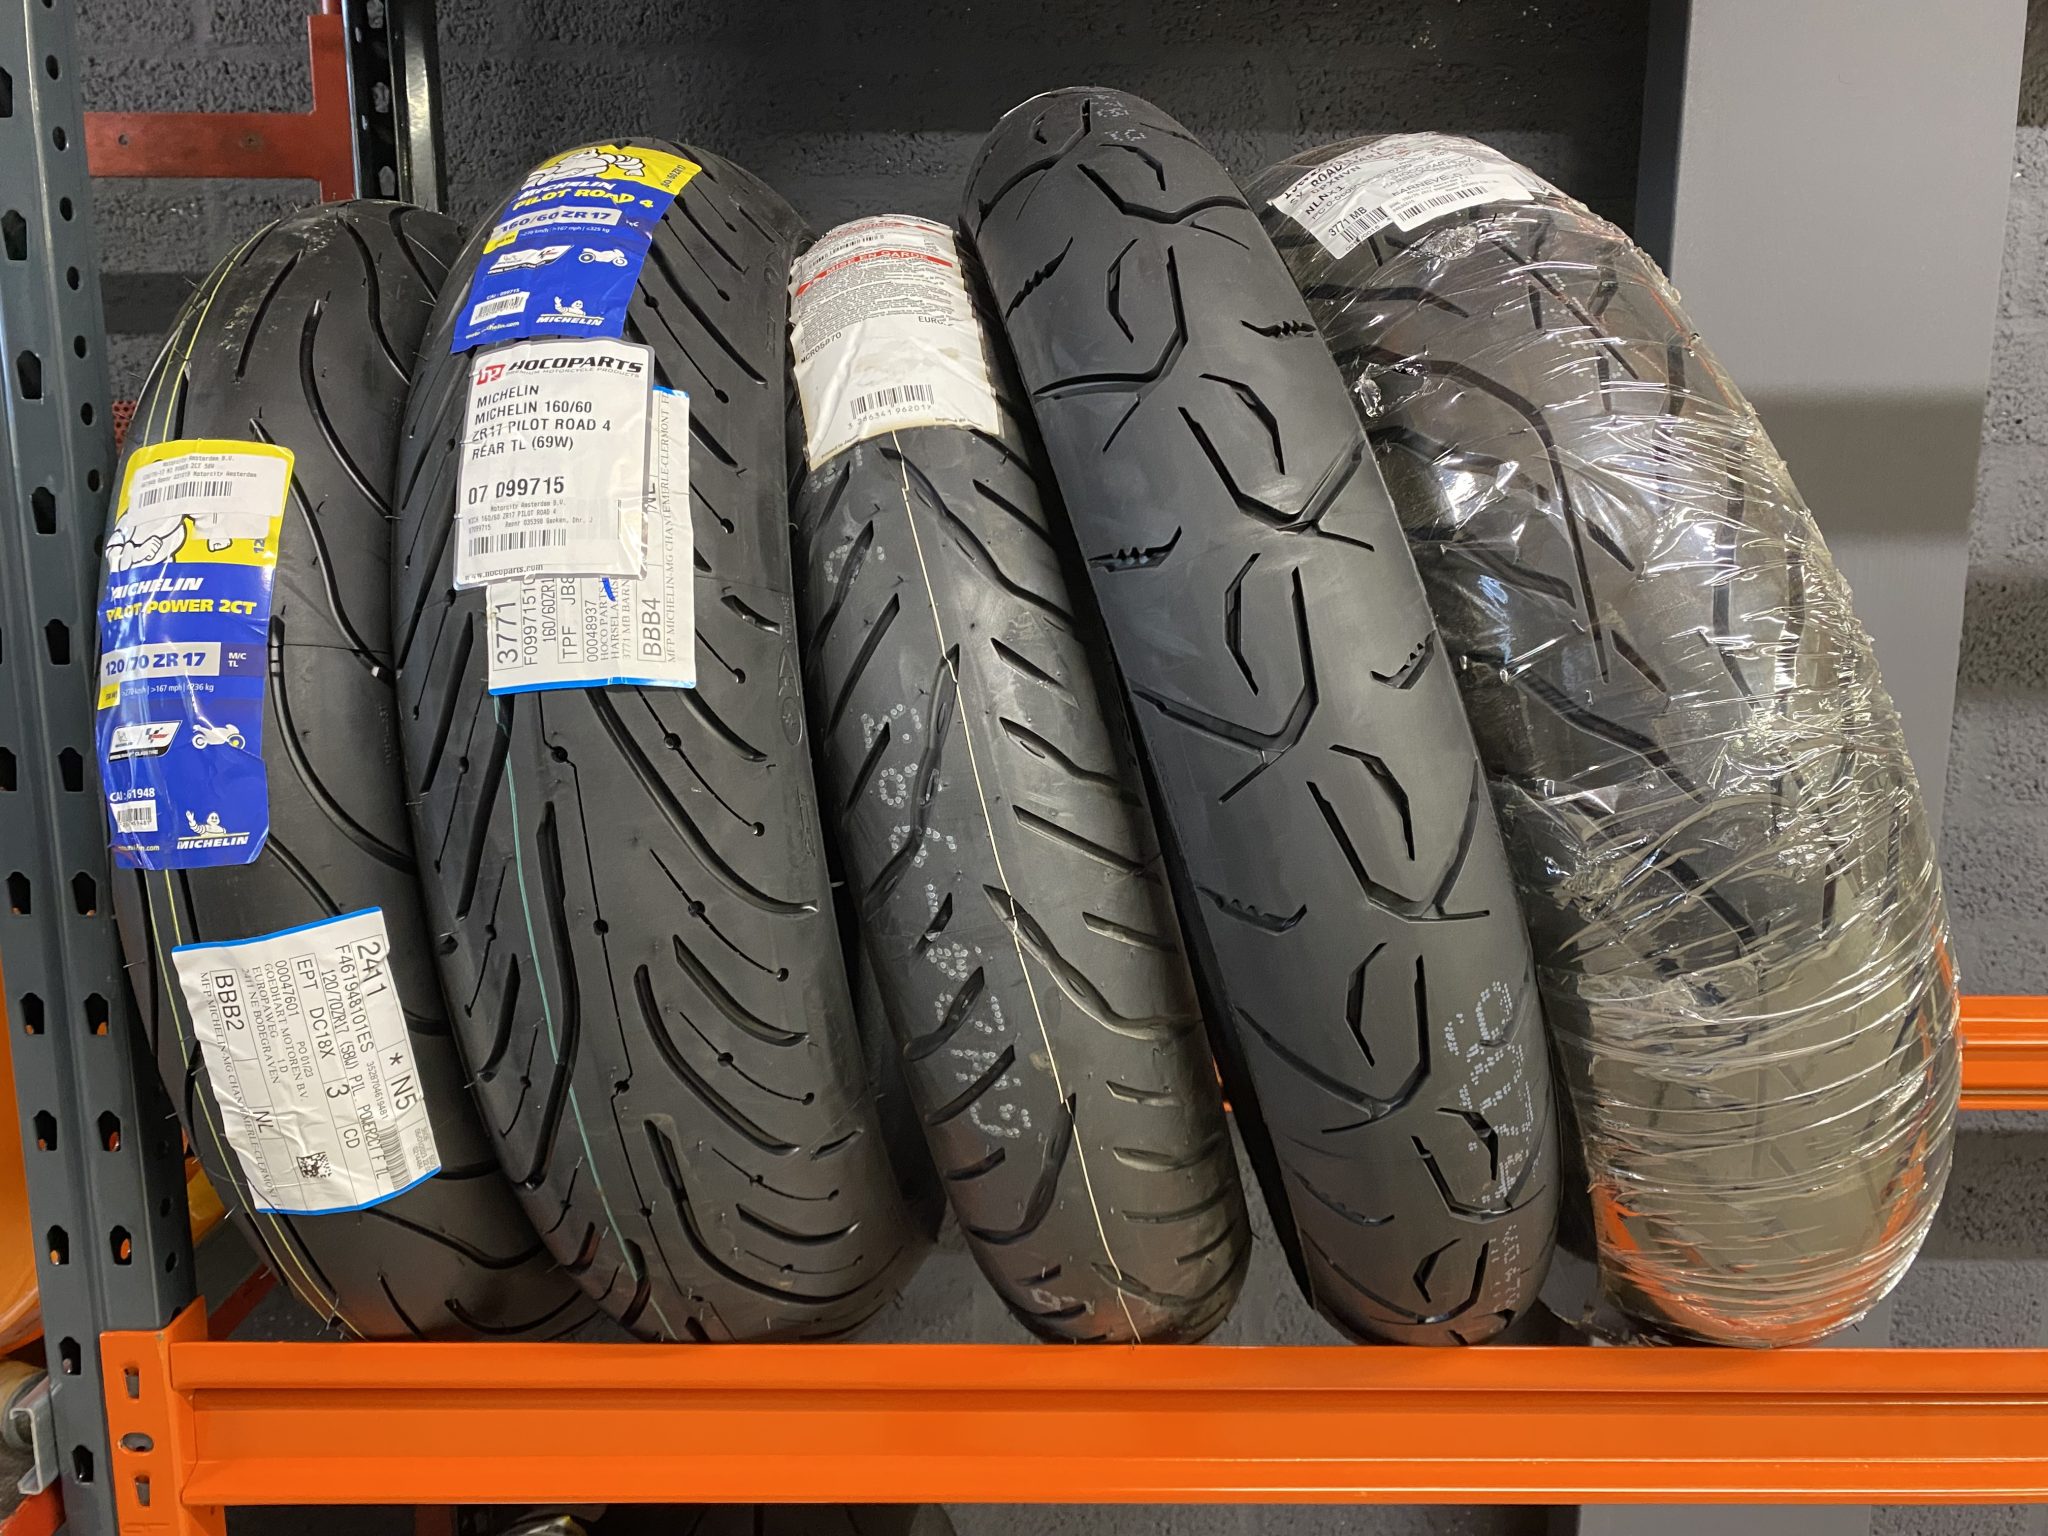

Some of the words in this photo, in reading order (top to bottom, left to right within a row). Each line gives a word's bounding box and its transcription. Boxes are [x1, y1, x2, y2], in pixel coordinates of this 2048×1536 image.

[512, 188, 573, 212] PILOT
[574, 189, 635, 205] ROAD
[640, 199, 654, 209] 4
[501, 211, 559, 233] 160/60
[560, 211, 590, 220] ZR
[591, 211, 611, 220] 17
[1328, 218, 1351, 237] 3771
[1349, 206, 1367, 220] MB
[859, 252, 877, 260] EN
[880, 250, 929, 260] GARDE
[535, 316, 605, 327] MICHELIN
[508, 355, 644, 374] HOCOPARTS
[543, 367, 594, 375] MOTORCYCLE
[597, 367, 640, 379] PRODUCTS
[476, 384, 539, 408] MICHELIN
[474, 401, 538, 425] MICHELIN
[545, 400, 592, 413] 160/60
[471, 423, 503, 442] ZR17
[508, 418, 549, 433] PILOT
[555, 418, 596, 431] ROAD
[602, 419, 611, 431] 4
[471, 441, 505, 460] REAR
[512, 439, 526, 451] TL
[531, 435, 574, 451] (69W)
[468, 485, 489, 505] 07
[495, 475, 565, 499] 099715
[517, 509, 534, 518] PILOT
[110, 577, 203, 599] MICHELIN
[663, 554, 676, 636] MICHELIN-MG
[146, 599, 214, 614] POWER
[218, 599, 257, 615] 2CT
[598, 587, 608, 625] PARTS
[494, 601, 518, 664] 3771
[584, 599, 599, 663] 00048937
[620, 614, 631, 633] MB
[641, 597, 662, 657] BBB4
[561, 624, 578, 659] TPF
[599, 628, 609, 661] HOCO
[621, 637, 632, 660] 3771
[665, 637, 676, 663] MFP
[105, 655, 150, 677] 120/70
[153, 653, 179, 668] ZR
[182, 652, 207, 667] 17
[228, 652, 247, 660] M/C
[150, 684, 167, 693] >167
[168, 684, 183, 693] mph
[204, 682, 214, 693] kg
[176, 835, 249, 850] MICHELIN
[199, 971, 212, 997] MFP
[248, 991, 260, 1006] NE
[321, 969, 350, 1038] 120/70ZR17
[252, 966, 278, 1039] EUROPAWEG
[279, 1065, 288, 1074] D
[264, 963, 287, 1025] GOEDHART
[280, 1026, 303, 1084] MOTOREN
[275, 959, 300, 1017] 00047601
[300, 1054, 313, 1077] 01/23
[357, 941, 387, 998] 2411
[390, 1075, 418, 1112] N5
[335, 944, 375, 1053] F461948101ES
[366, 1060, 389, 1119] 3528704619481
[214, 974, 245, 1031] BBB2
[253, 1110, 275, 1134] NL
[253, 1008, 281, 1085] BODEGRAVEN
[297, 958, 320, 990] EPT
[309, 1007, 336, 1060] DC18X
[326, 1083, 352, 1100] 3
[343, 1128, 361, 1149] CD
[340, 1040, 360, 1070] (58W)
[371, 1154, 384, 1163] F
[375, 1166, 388, 1180] TL
